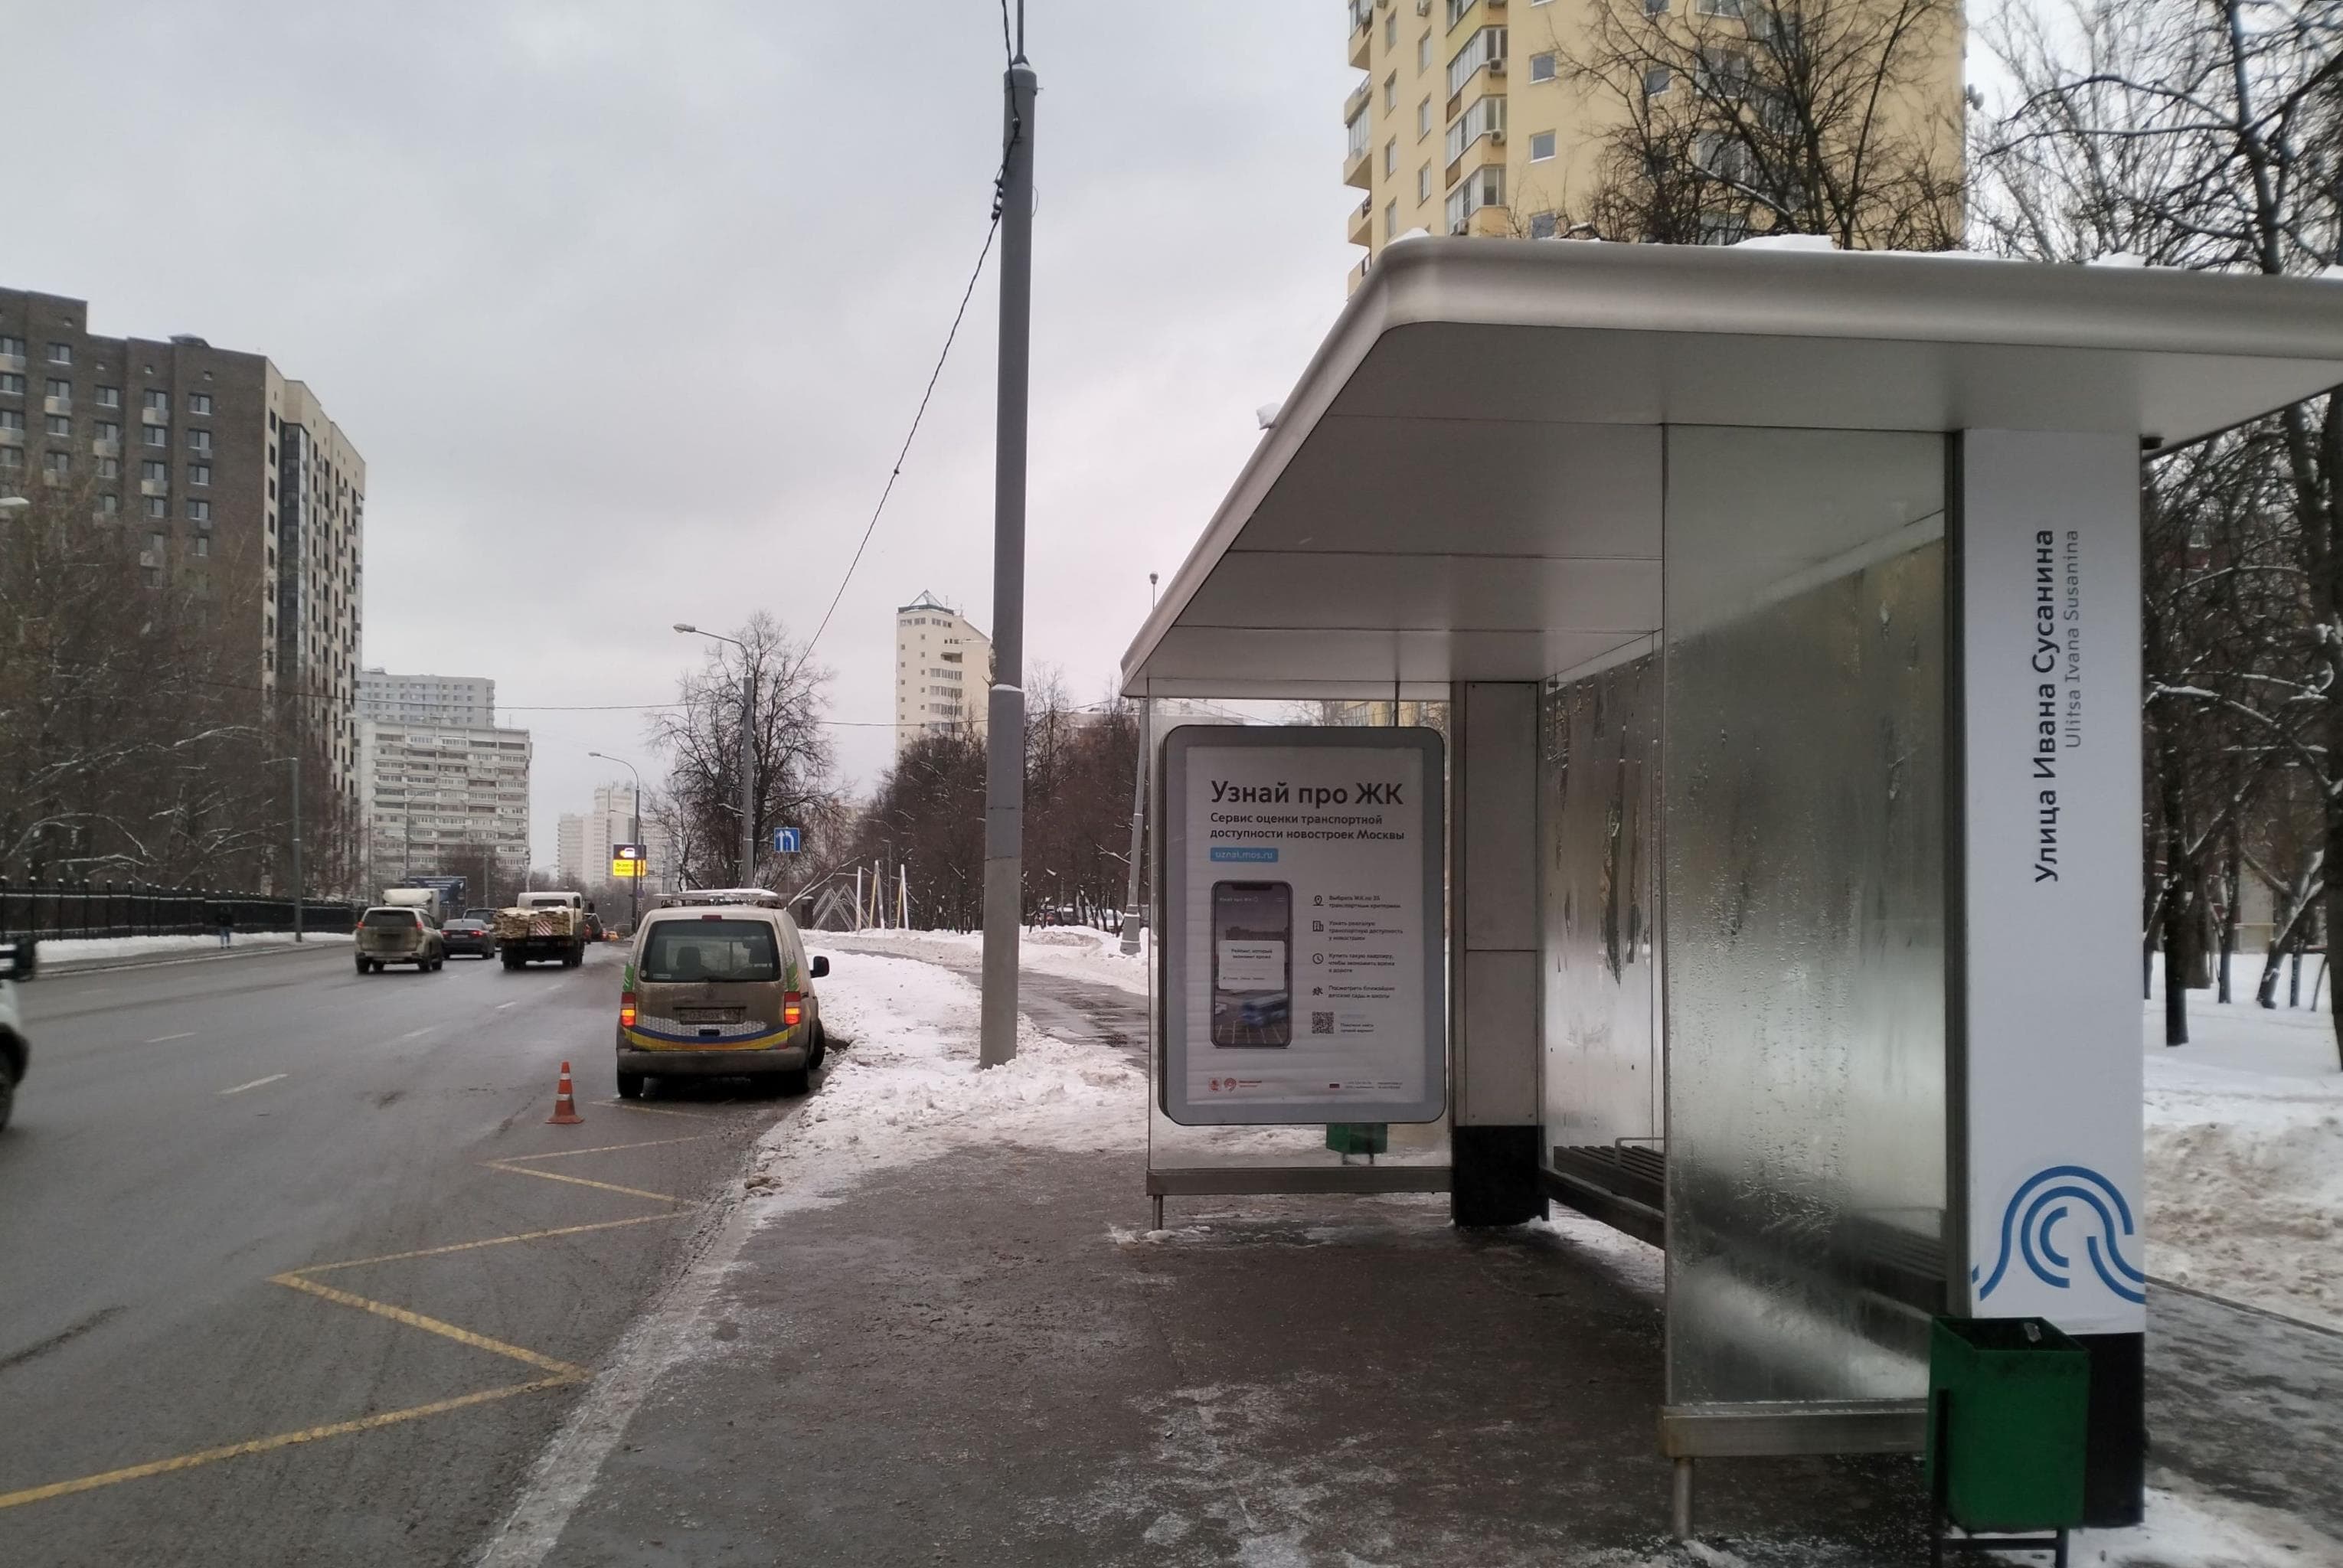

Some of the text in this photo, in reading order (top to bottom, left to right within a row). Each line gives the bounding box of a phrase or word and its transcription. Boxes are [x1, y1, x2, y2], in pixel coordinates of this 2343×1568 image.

[2063, 531, 2081, 748] Ulitsa Ivana Susanina
[2032, 530, 2060, 883] Улица Ивана Сусанина
[1211, 780, 1404, 808] Узнай про ЖК
[1211, 812, 1383, 826] Сервис оценки транспортной
[1210, 829, 1404, 841] доступности новостроек Москвы
